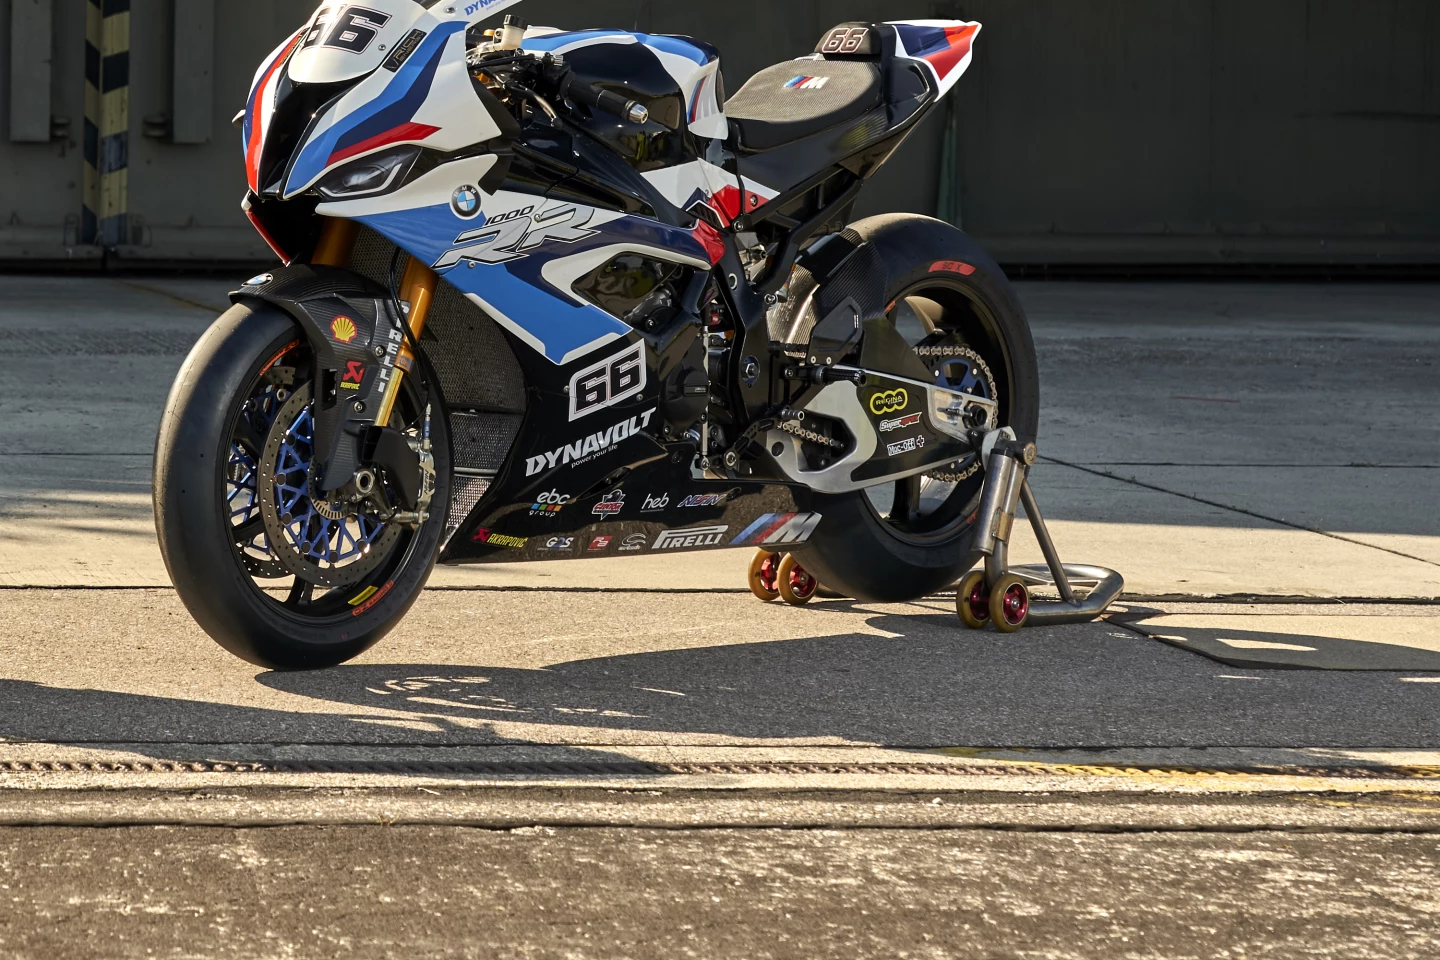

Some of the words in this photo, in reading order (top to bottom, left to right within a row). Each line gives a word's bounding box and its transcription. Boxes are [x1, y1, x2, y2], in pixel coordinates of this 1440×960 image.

[821, 27, 869, 53] 66
[484, 205, 536, 227] 1000
[431, 203, 601, 270] RR
[572, 344, 643, 416] 66
[876, 395, 903, 406] REGINA
[525, 406, 657, 477] DYNAVOLT
[571, 456, 592, 469] power
[592, 449, 609, 461] your
[608, 444, 618, 453] life
[536, 488, 571, 505] ebc
[641, 492, 670, 509] heb
[528, 509, 556, 517] group
[651, 524, 729, 549] PIRELLI
